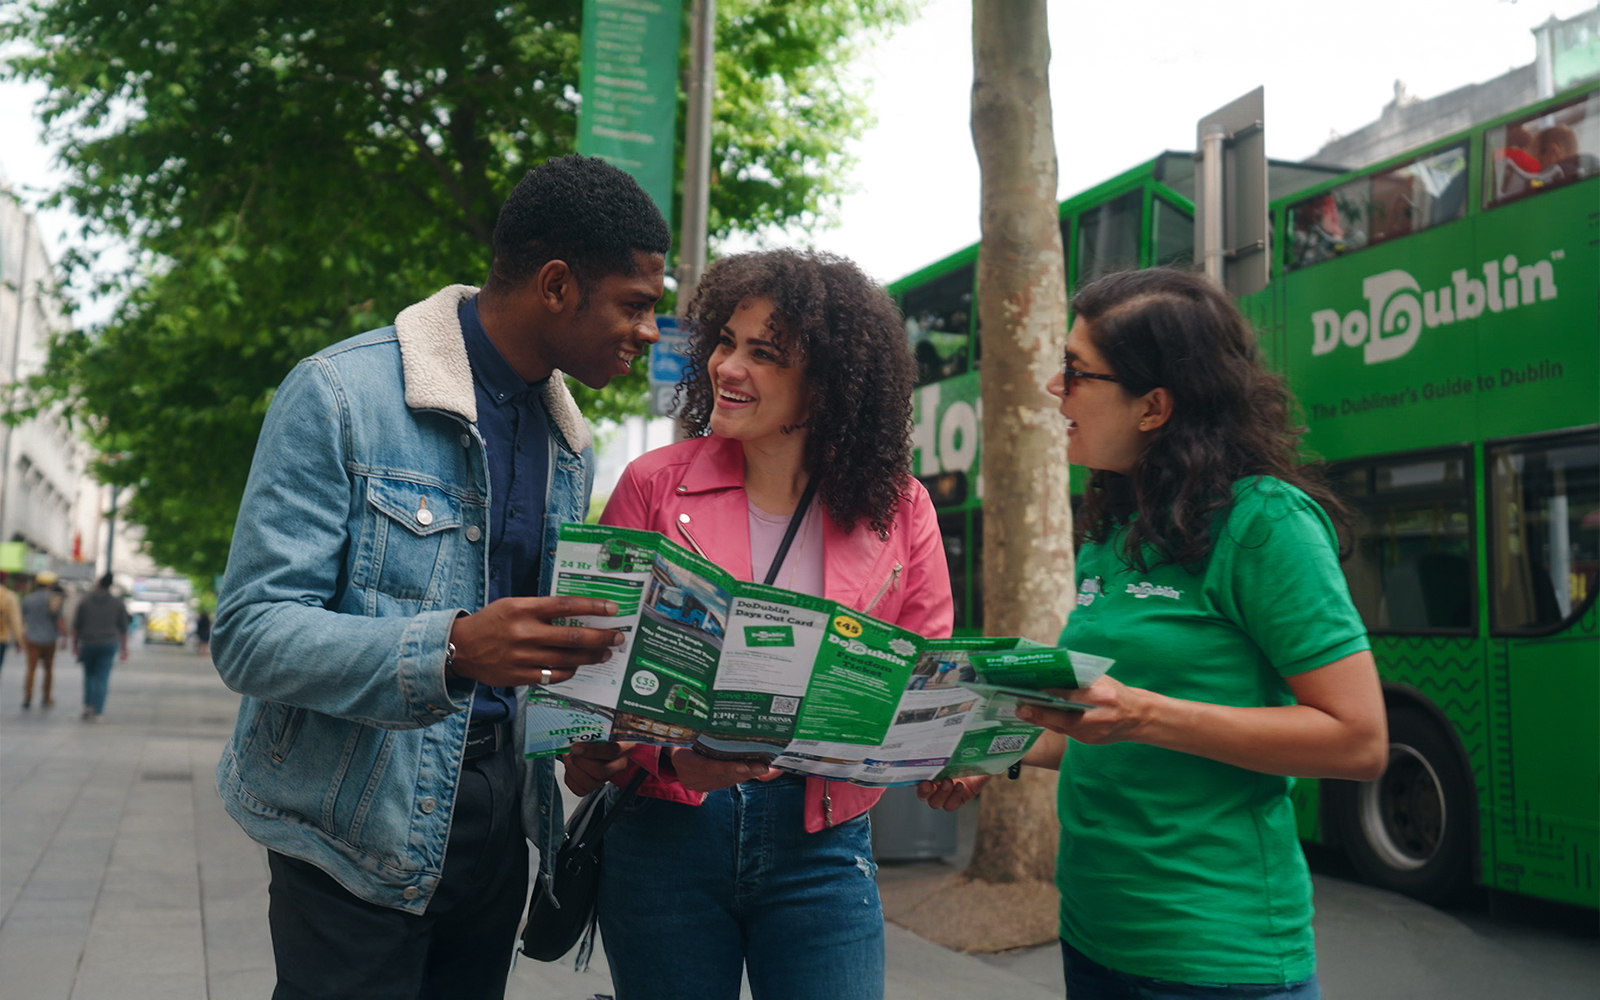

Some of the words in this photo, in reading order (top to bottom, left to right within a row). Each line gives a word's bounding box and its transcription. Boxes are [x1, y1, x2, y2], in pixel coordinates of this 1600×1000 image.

[1311, 254, 1557, 365] DoDublin
[1311, 404, 1337, 420] The
[1341, 387, 1418, 416] Dubliner's
[1422, 378, 1473, 400] Guide
[1477, 375, 1496, 391] to
[1500, 359, 1563, 386] Dublin
[560, 560, 574, 568] 24
[577, 561, 592, 570] Hr
[737, 600, 790, 615] DoDublin
[735, 609, 762, 619] Days
[764, 613, 785, 622] Out
[787, 617, 814, 627] Card
[828, 633, 907, 667] DoDublin
[836, 651, 892, 673] Freedom
[842, 660, 882, 677] Ticket
[636, 676, 656, 688] €35
[717, 692, 742, 700] Save
[713, 712, 739, 720] EPIC
